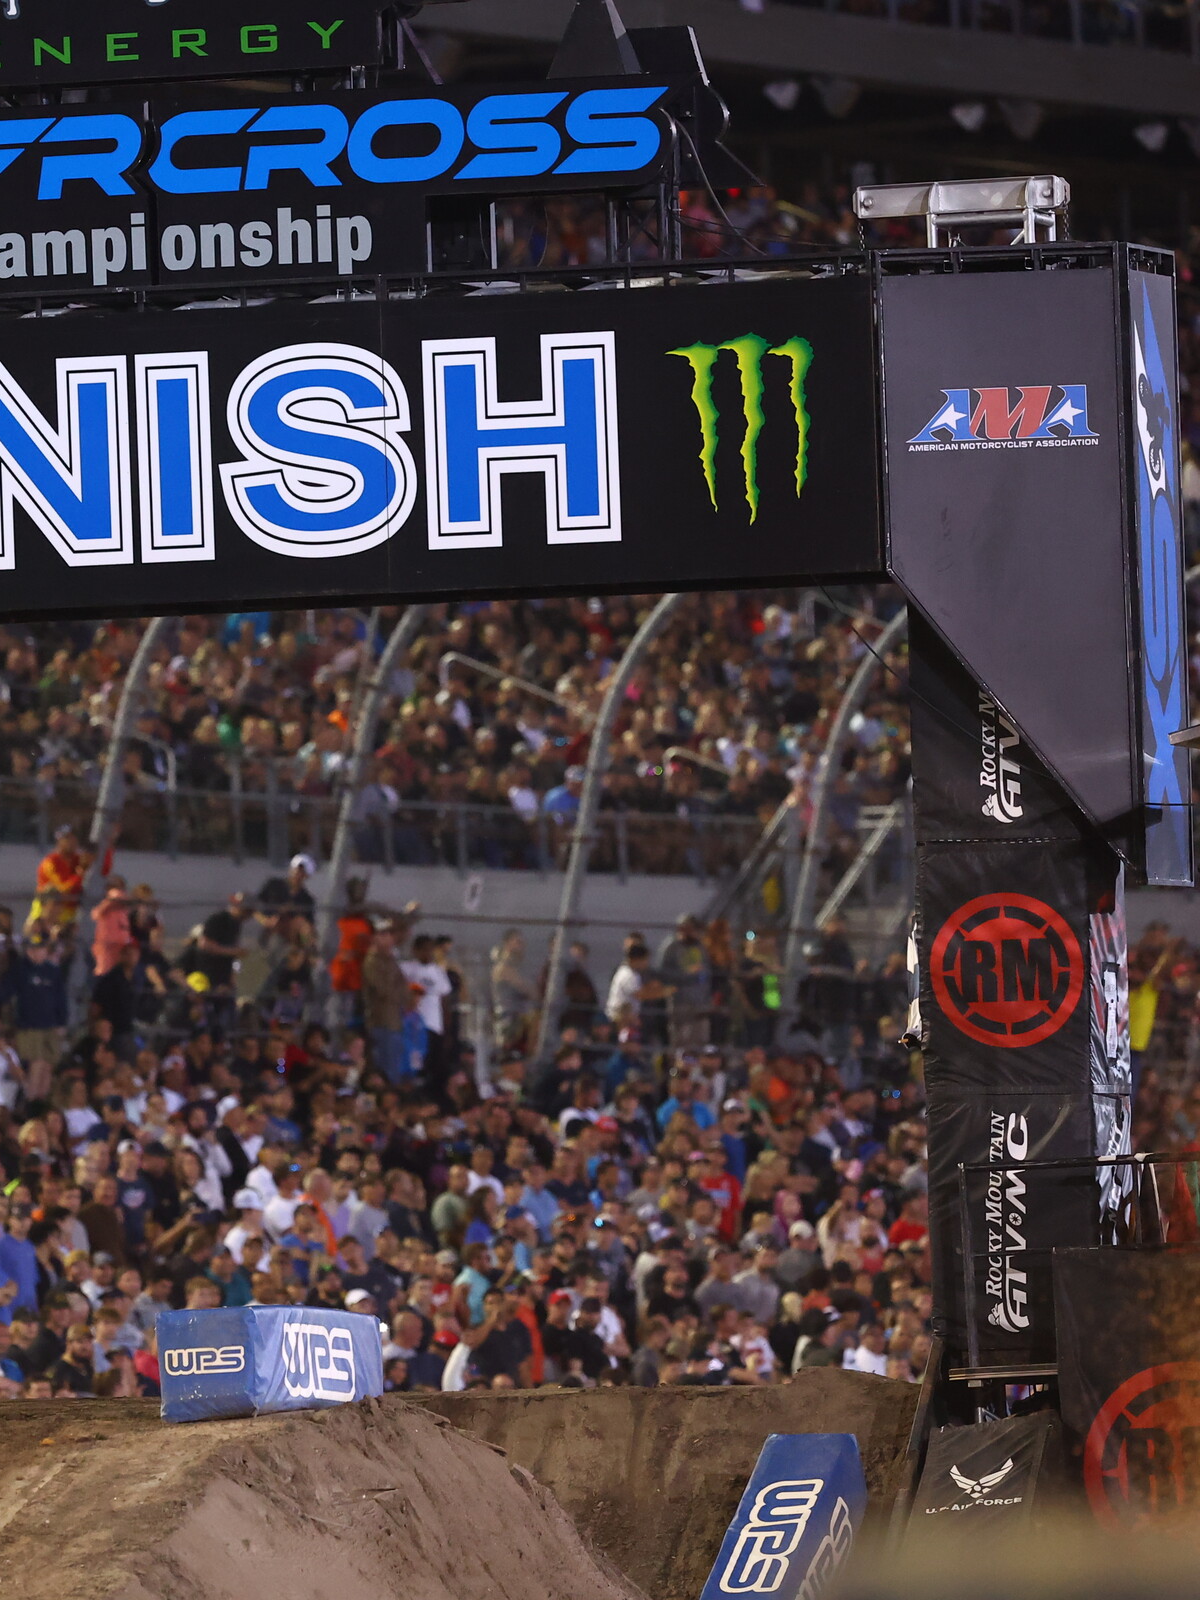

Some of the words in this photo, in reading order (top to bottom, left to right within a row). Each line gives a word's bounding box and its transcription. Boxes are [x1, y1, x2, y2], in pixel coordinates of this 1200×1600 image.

[905, 384, 1101, 443] AMA
[908, 443, 959, 452] AMERICAN
[960, 440, 1034, 450] MOTORCYCLIST
[1035, 438, 1099, 448] ASSOCIATION
[980, 720, 998, 790] ROCKY
[960, 938, 1052, 1004] RM
[985, 1111, 1006, 1227] MOUTAIN
[986, 1228, 1004, 1299] ROCKY
[163, 1344, 246, 1377] WPS
[281, 1322, 356, 1403] WPS
[719, 1478, 825, 1594] WPS
